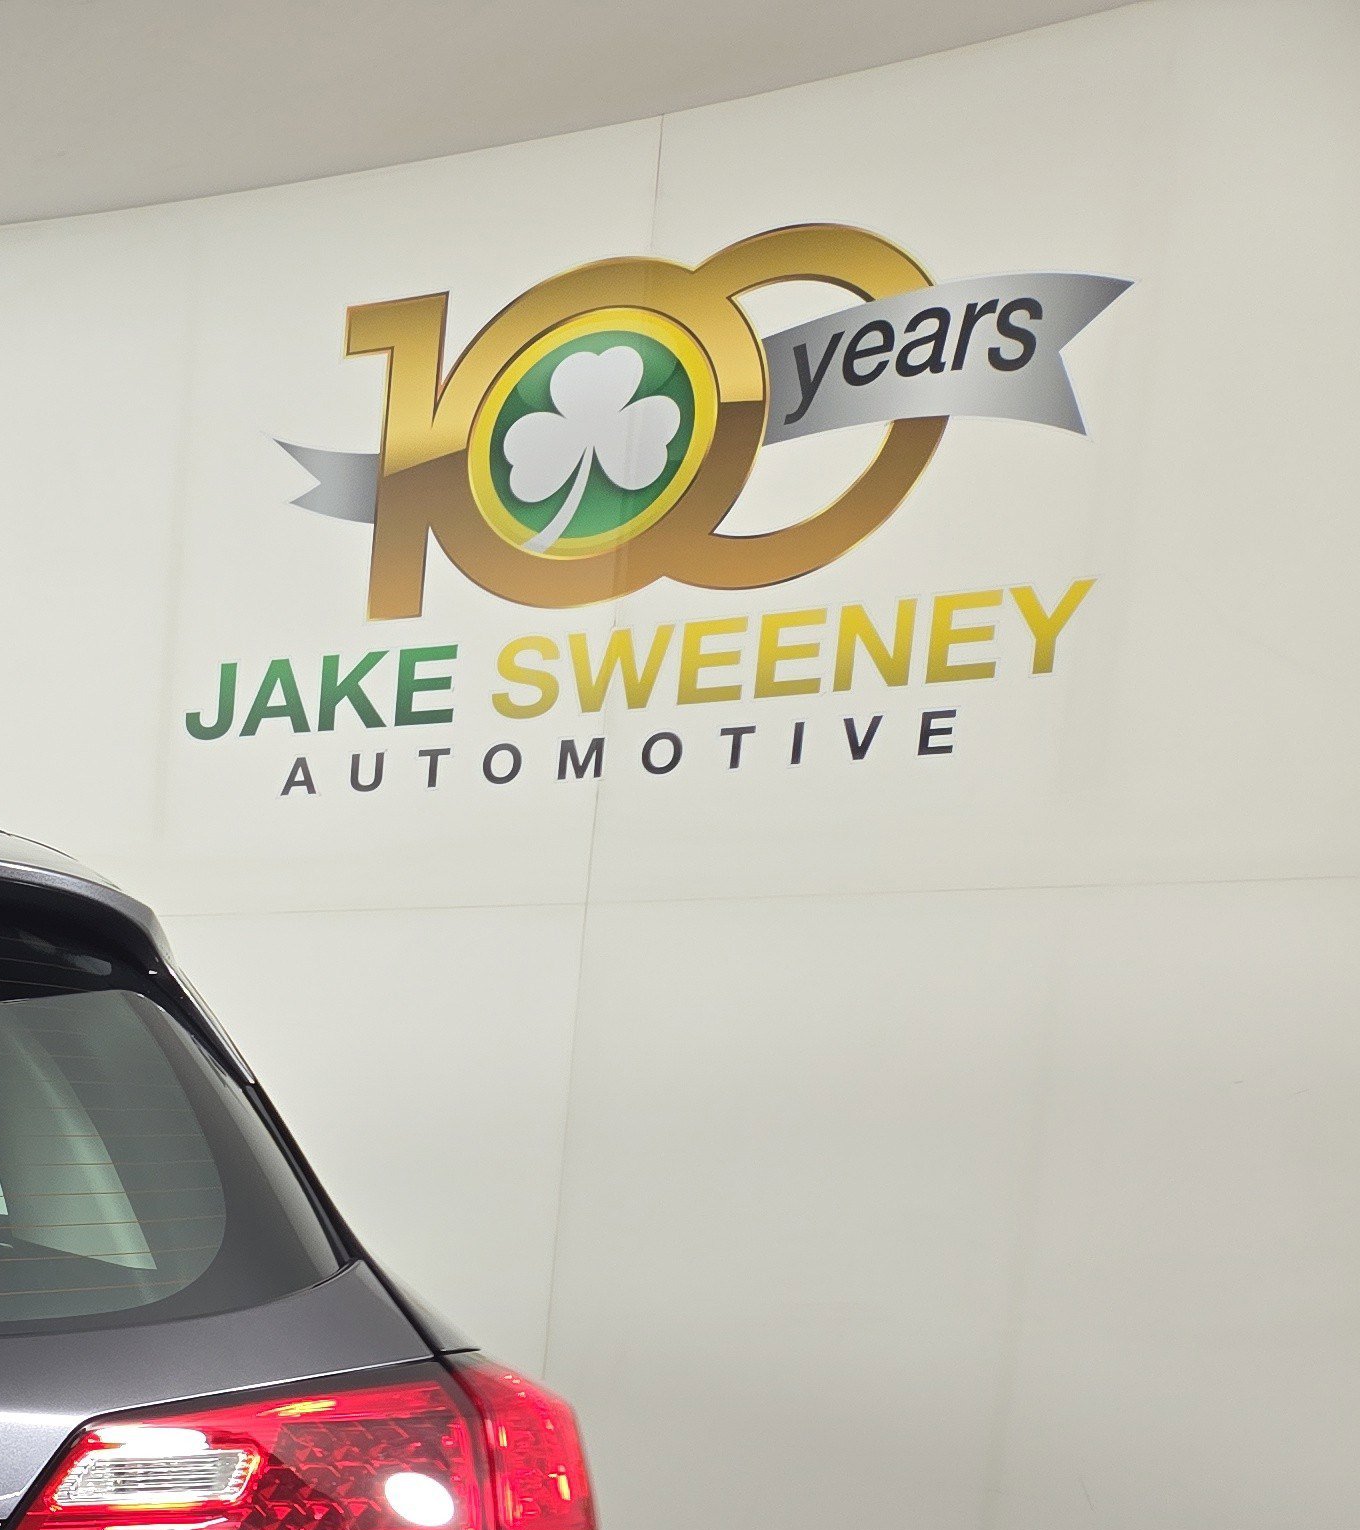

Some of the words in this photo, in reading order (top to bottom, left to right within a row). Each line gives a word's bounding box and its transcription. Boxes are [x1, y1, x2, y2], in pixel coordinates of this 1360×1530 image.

[344, 223, 949, 621] 100
[783, 295, 1043, 425] years
[185, 643, 459, 742] JAKE
[491, 579, 1099, 721] SWEENEY
[279, 708, 957, 797] AUTOMOTIVE
